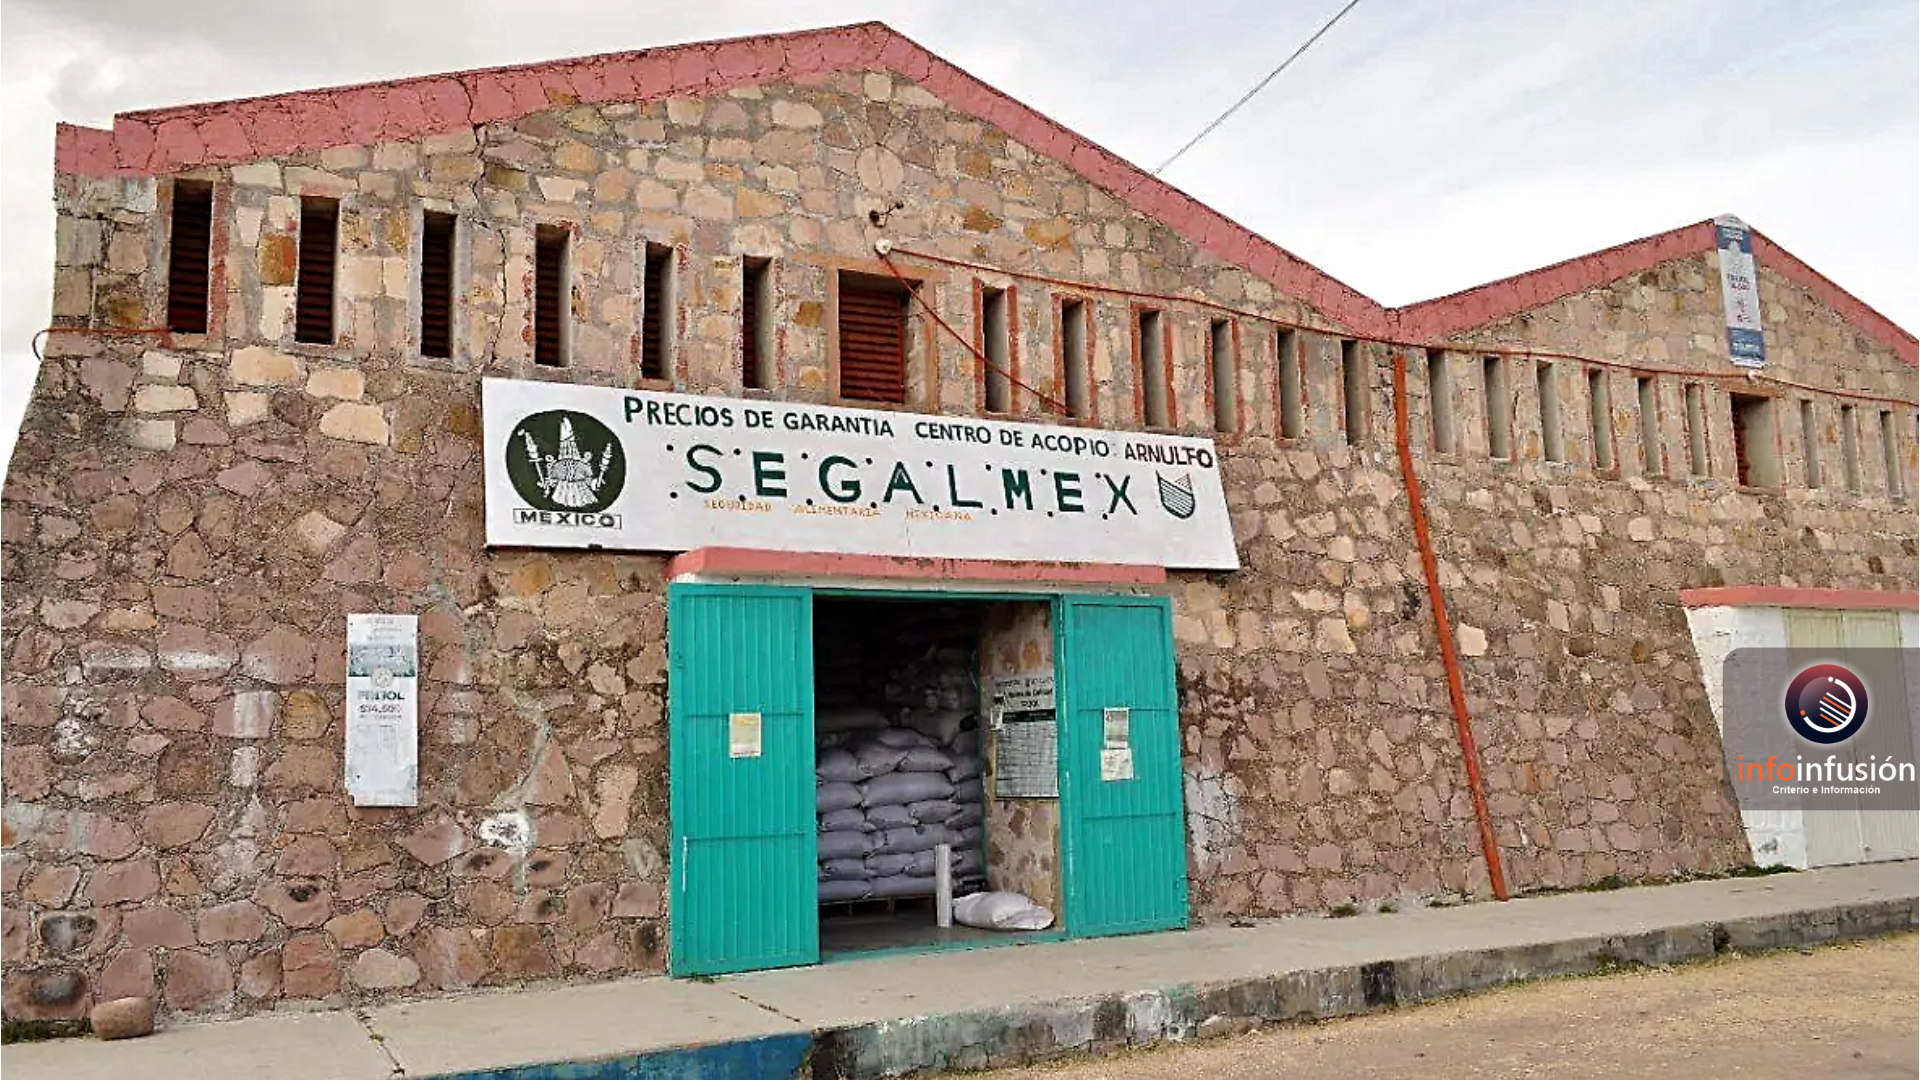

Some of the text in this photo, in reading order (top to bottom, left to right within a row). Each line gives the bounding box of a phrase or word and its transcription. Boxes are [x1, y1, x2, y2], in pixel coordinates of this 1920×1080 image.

[624, 395, 1214, 468] PRECIOS DE GARANTIA CENTRO DE ACOPIO ARNULFO
[520, 510, 616, 528] MEXICO
